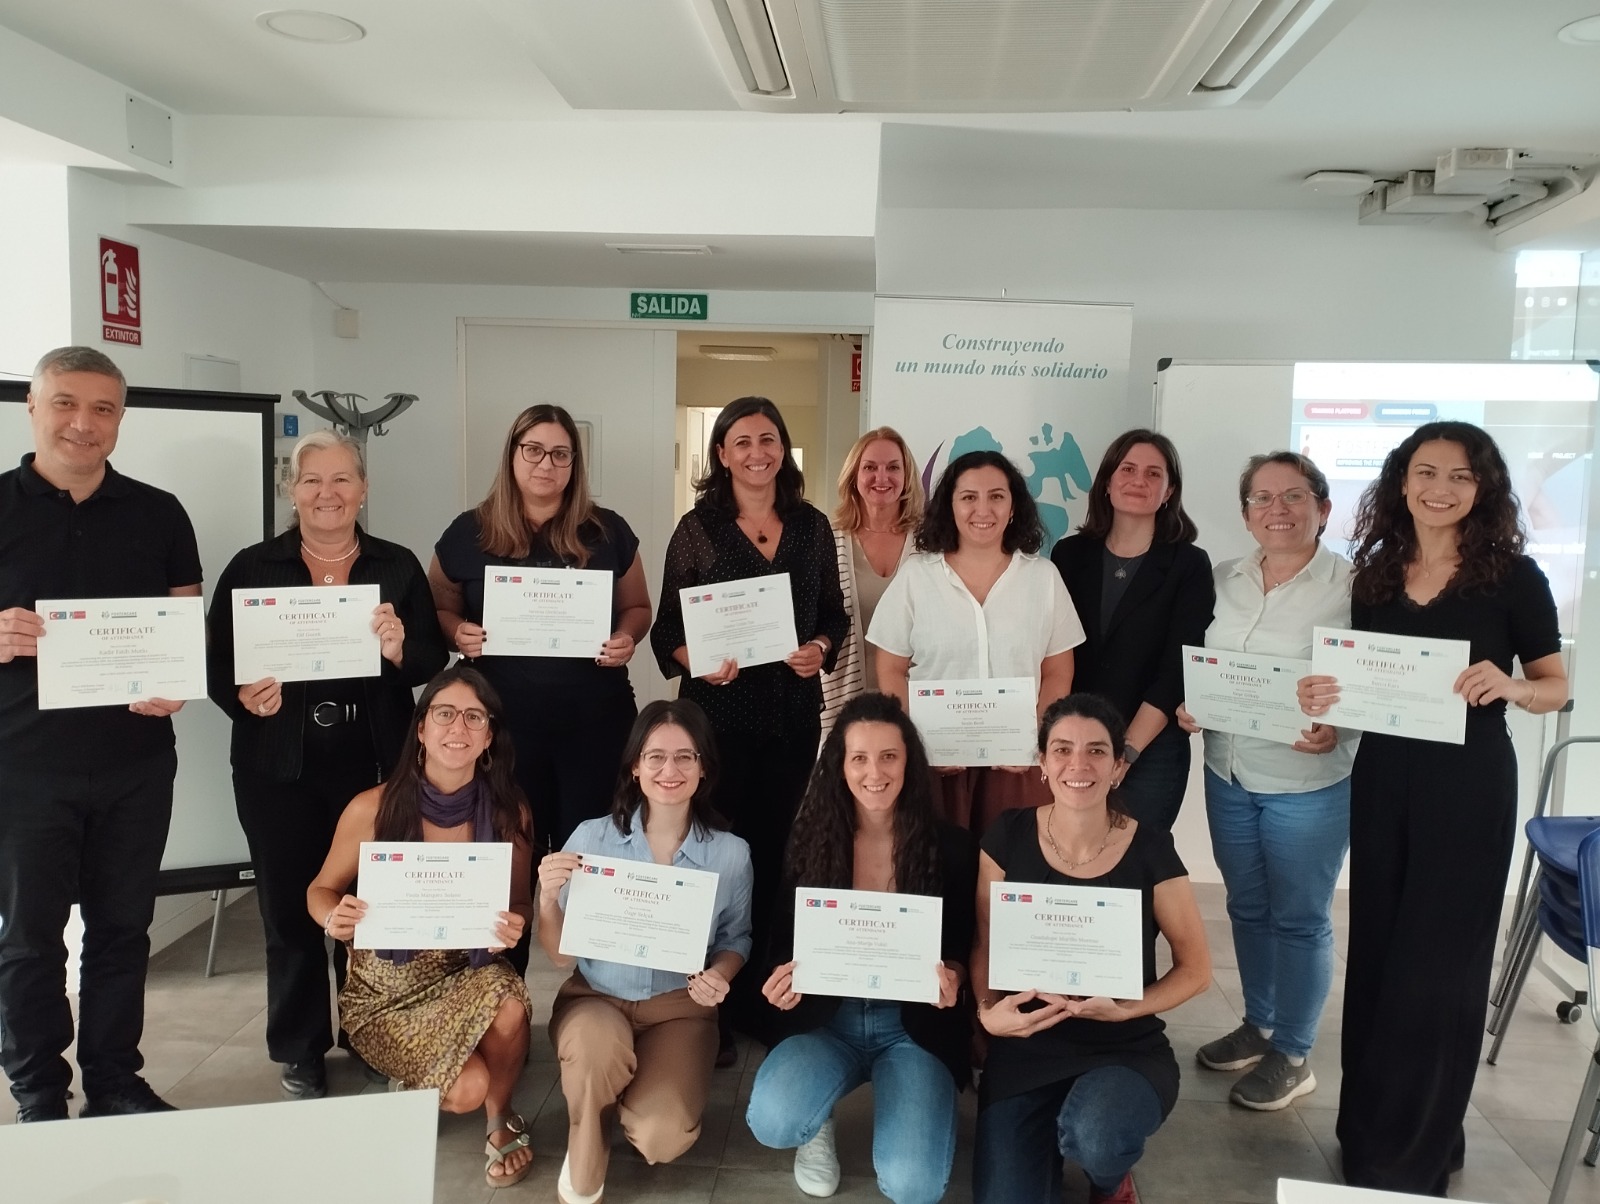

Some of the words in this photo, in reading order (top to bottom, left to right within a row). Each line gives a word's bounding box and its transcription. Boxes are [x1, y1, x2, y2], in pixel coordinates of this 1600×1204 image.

[637, 296, 701, 314] SALIDA
[105, 328, 139, 343] EXTINTOR
[942, 333, 1065, 356] Construyendo
[895, 361, 918, 373] un
[924, 359, 985, 375] mundo
[991, 360, 1026, 377] más
[1031, 362, 1108, 379] solidario
[523, 591, 574, 599] CERTIFICATE
[715, 601, 759, 613] CERTIFICATE
[278, 612, 337, 621] CERTIFICATE
[89, 626, 156, 636] CERTIFICATE
[1356, 658, 1417, 672] CERTIFICATE
[1219, 673, 1272, 685] CERTIFICATE
[946, 702, 997, 710] CERTIFICATE
[404, 871, 465, 879] CERTIFICATE
[613, 887, 672, 902] CERTIFICATE
[838, 918, 897, 929] CERTIFICATE
[1034, 913, 1095, 924] CERTIFICATE
